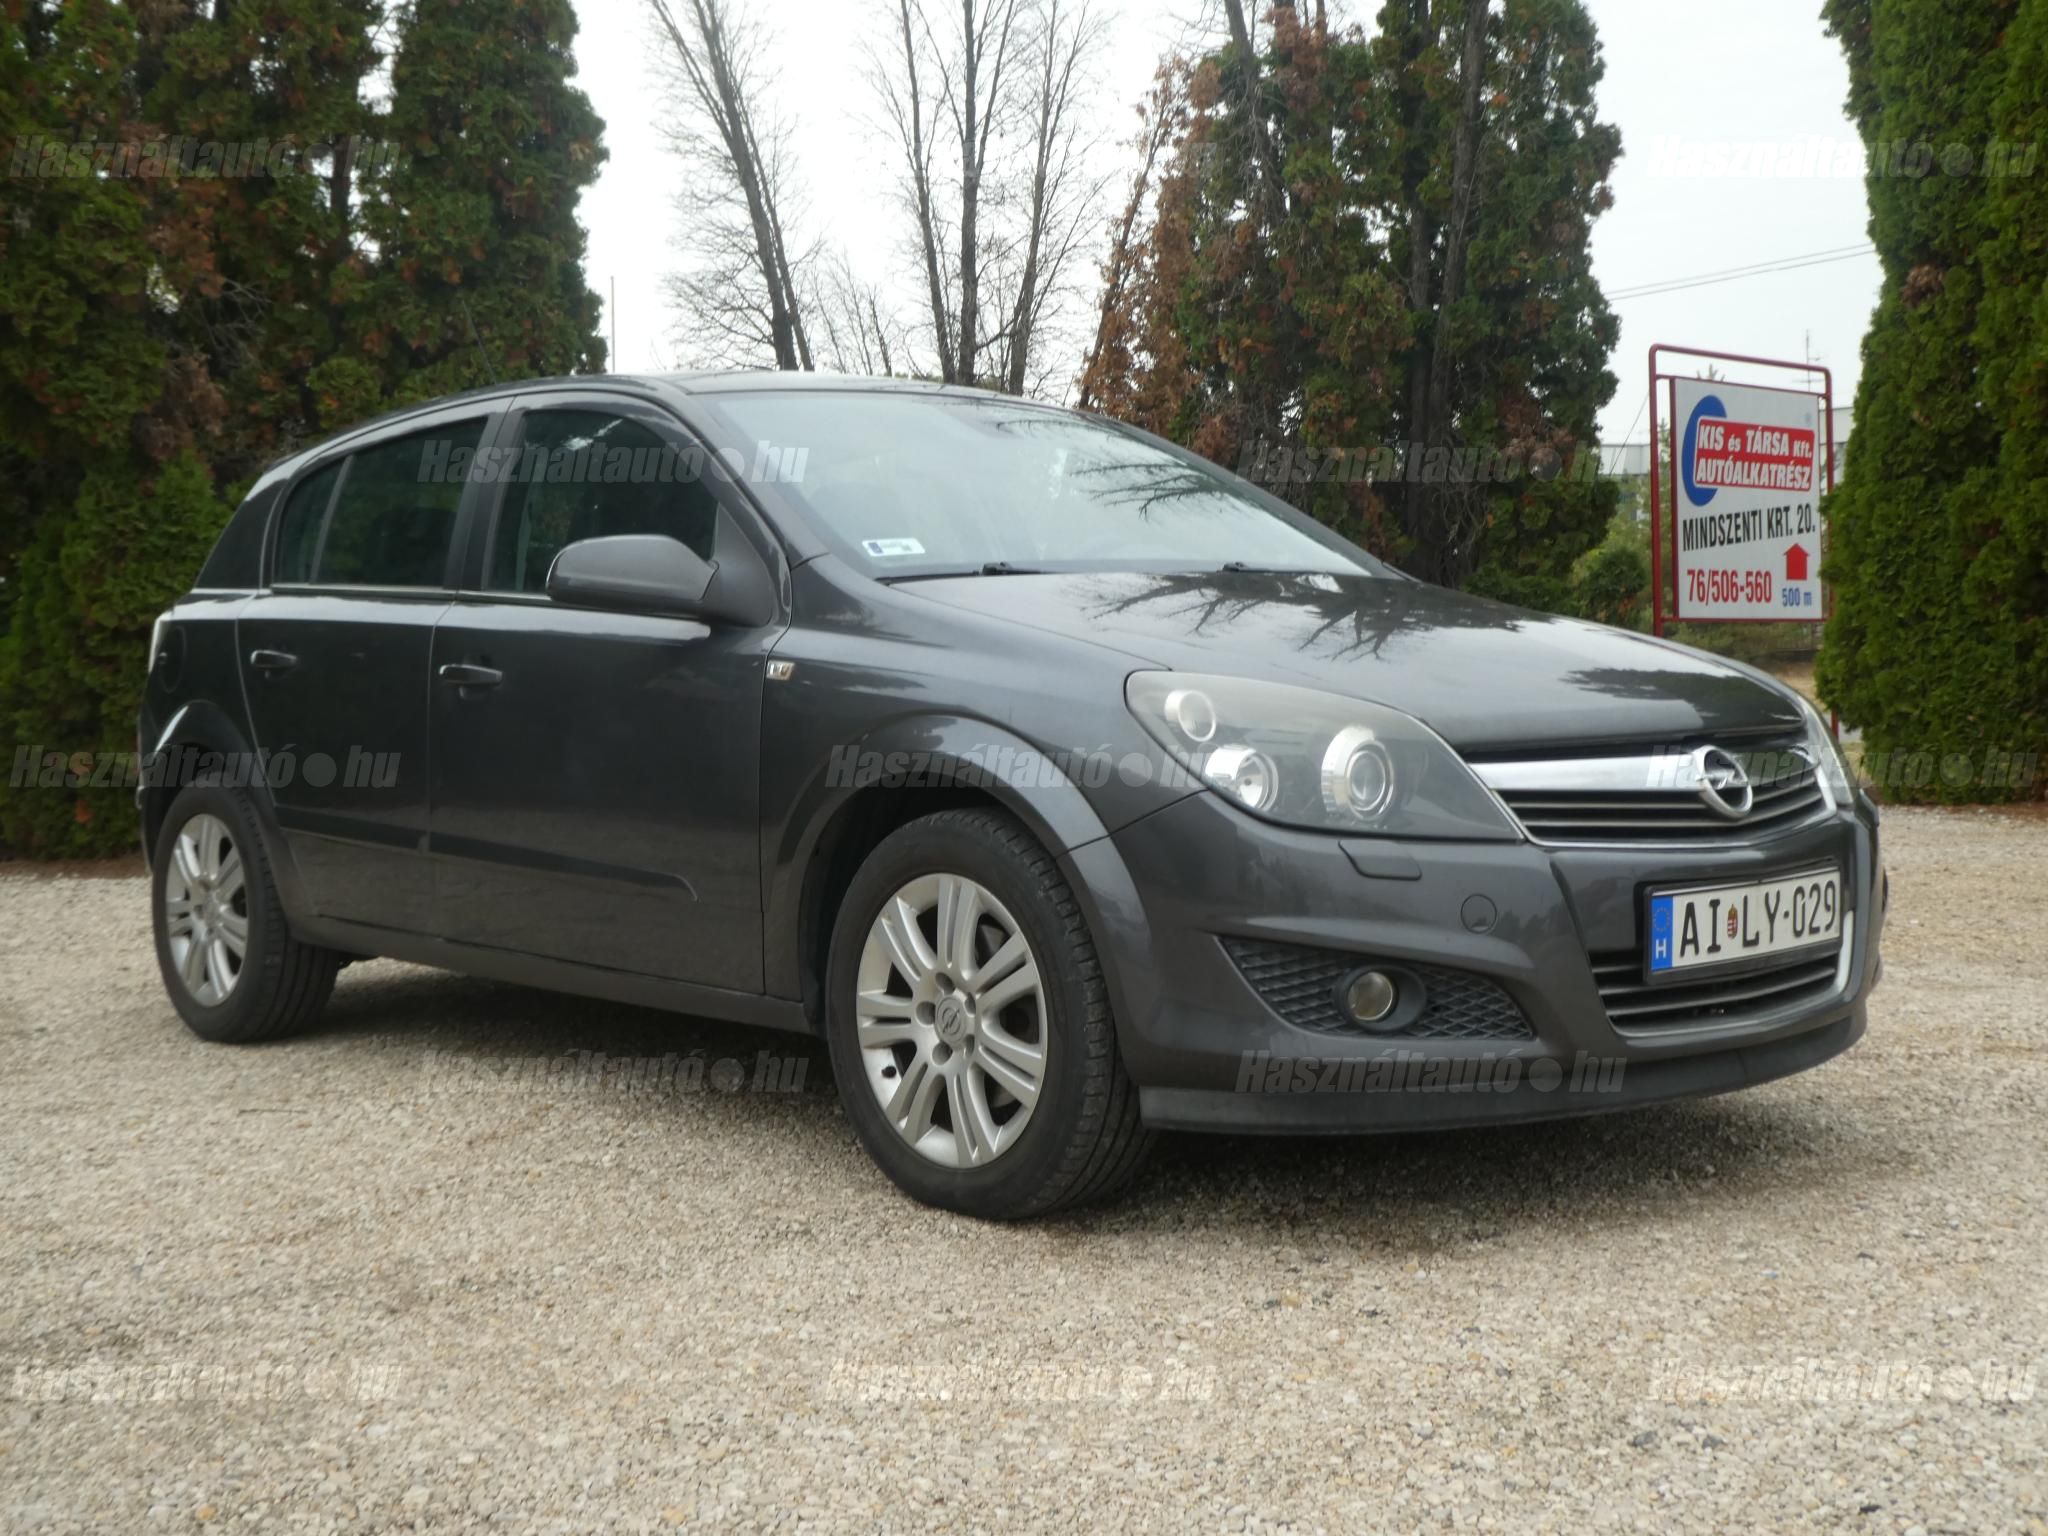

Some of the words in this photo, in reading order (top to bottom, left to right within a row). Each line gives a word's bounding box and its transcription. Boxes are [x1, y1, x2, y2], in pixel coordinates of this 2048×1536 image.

[1699, 425, 1724, 451] KIS
[1728, 434, 1740, 452] és
[1746, 424, 1789, 457] TÁRSA
[1696, 456, 1810, 489] AUTÓALKATRÉSZ
[1683, 509, 1762, 551] MINDSZENTI
[1767, 506, 1793, 539] KRT.
[1797, 503, 1815, 534] 20.
[1687, 569, 1772, 606] 76/506-560
[1782, 588, 1800, 607] 500
[1803, 590, 1812, 606] m
[1680, 899, 1721, 957] AI
[1743, 880, 1836, 948] LY-029
[1655, 938, 1667, 960] H
